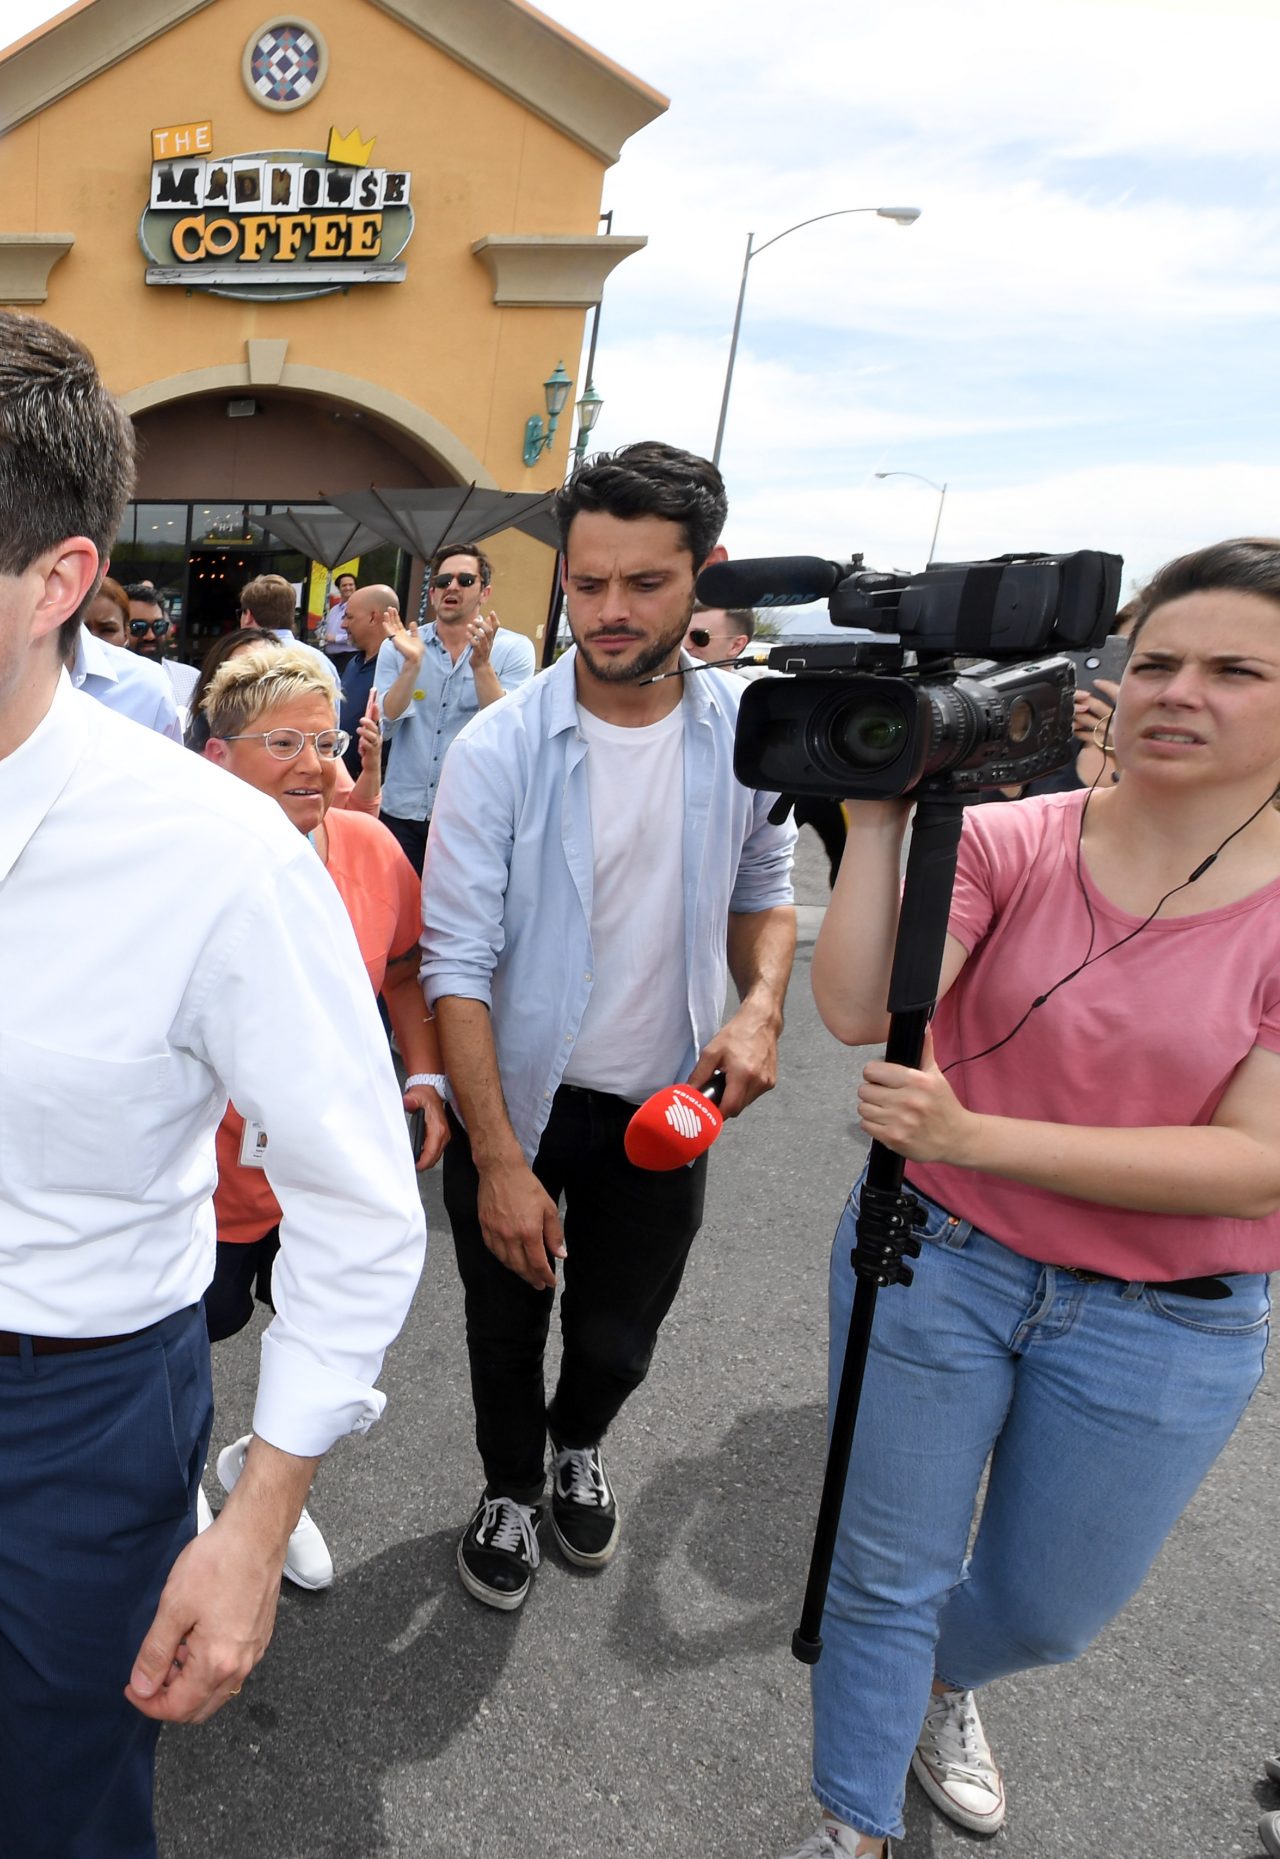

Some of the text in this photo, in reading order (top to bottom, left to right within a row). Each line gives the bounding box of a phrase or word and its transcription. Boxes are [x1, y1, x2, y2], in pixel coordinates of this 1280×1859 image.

[154, 126, 211, 154] THE
[154, 162, 408, 208] MADHOUSE
[171, 214, 383, 262] COFFEE
